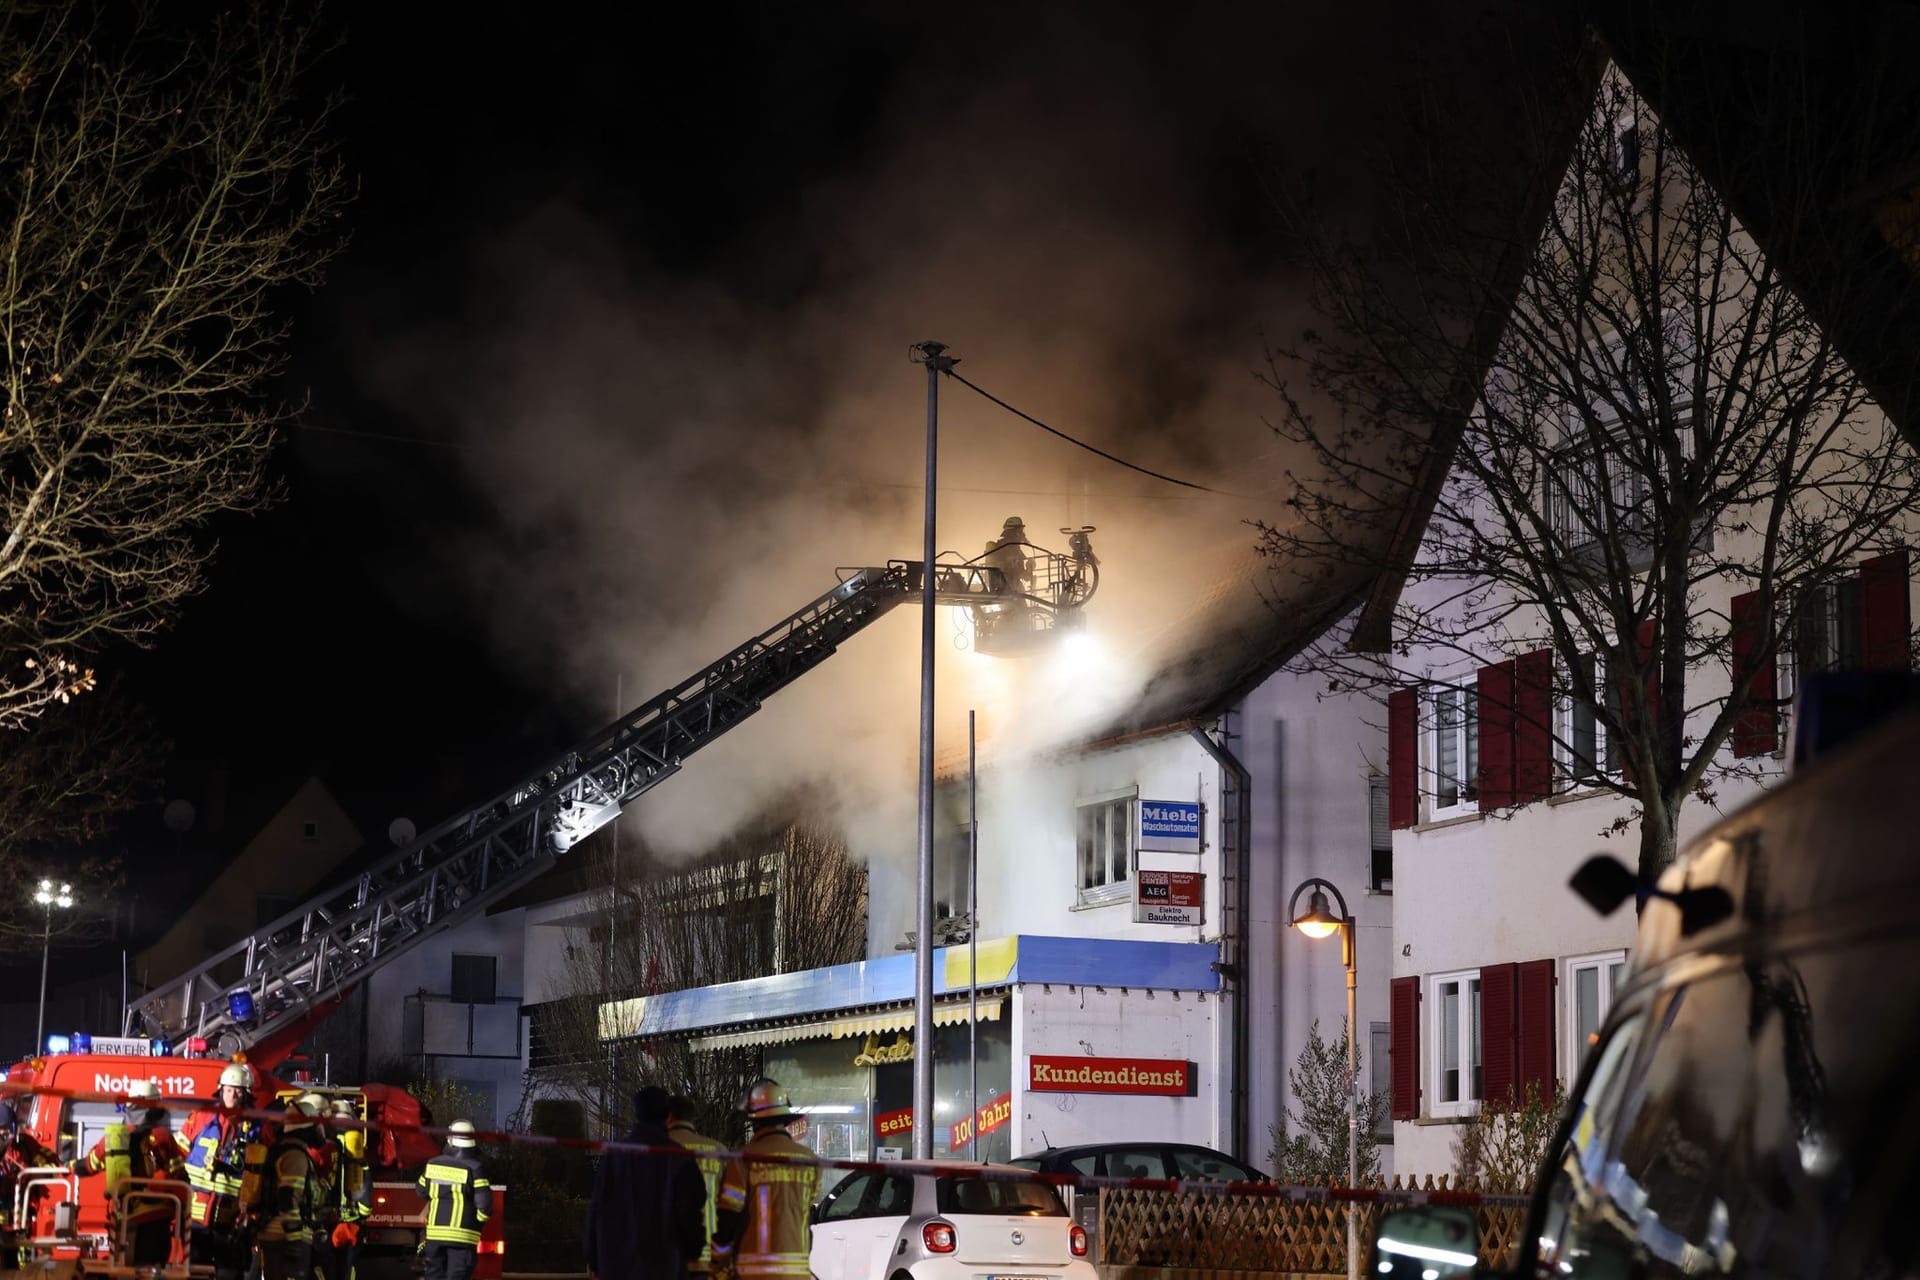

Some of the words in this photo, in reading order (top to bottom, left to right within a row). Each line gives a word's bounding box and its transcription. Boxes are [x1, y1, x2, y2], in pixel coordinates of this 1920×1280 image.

[1142, 808, 1198, 822] Miele
[1142, 822, 1198, 833] Waschautomaten
[1146, 887, 1167, 896] AEG
[1148, 912, 1190, 922] Bauknecht
[91, 1042, 147, 1056] UERWEHR
[1033, 1064, 1184, 1087] Kundendienst
[165, 1076, 195, 1095] 112
[880, 1113, 913, 1133] seit
